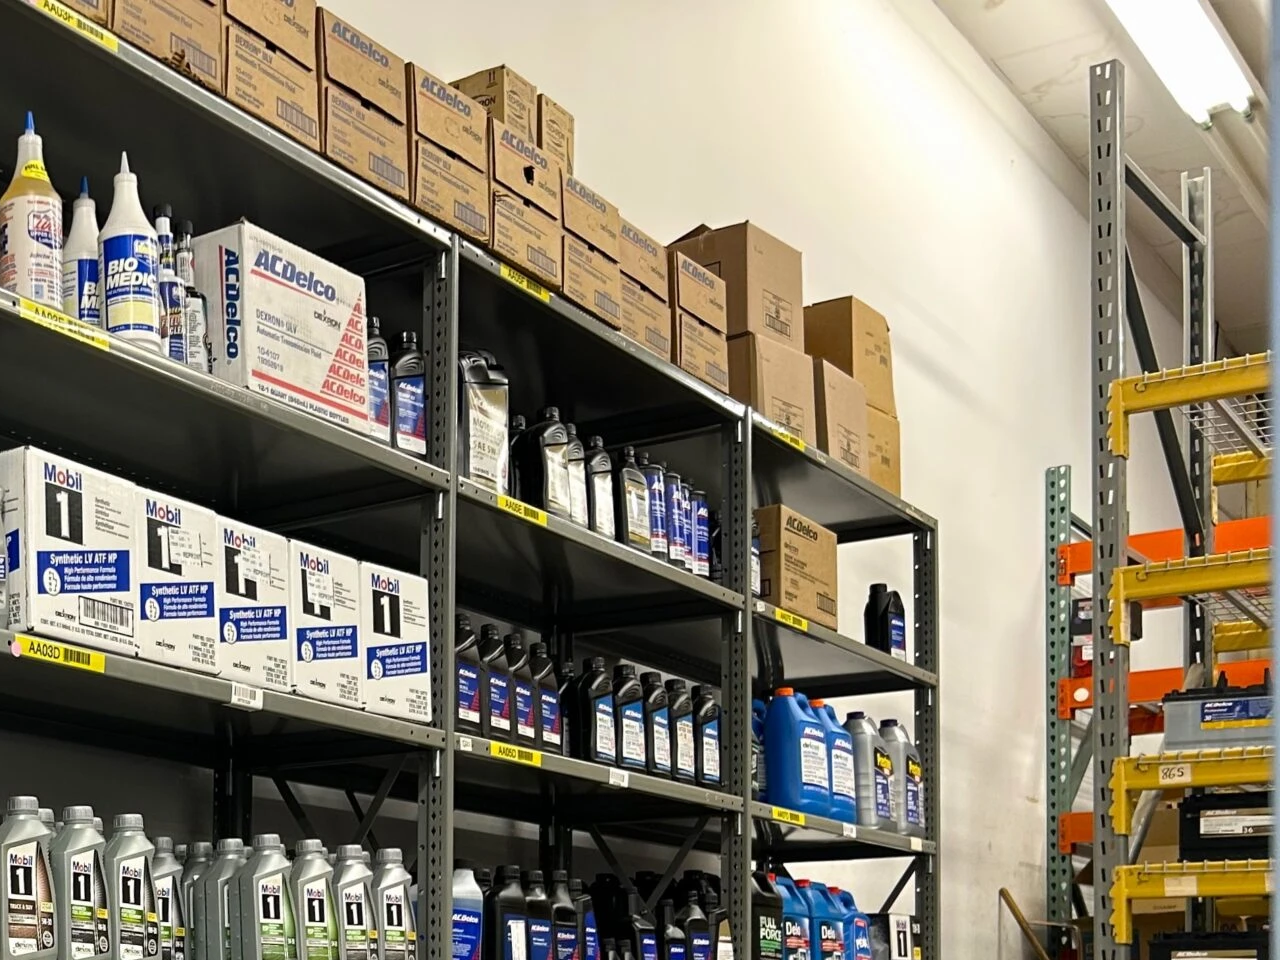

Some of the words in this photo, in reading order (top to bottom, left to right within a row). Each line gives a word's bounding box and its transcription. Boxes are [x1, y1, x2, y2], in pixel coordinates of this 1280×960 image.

[332, 20, 390, 69] ACDelco
[421, 75, 472, 118] ACDelco
[500, 129, 548, 169] ACDelco
[565, 177, 607, 213] ACDelco
[107, 257, 138, 274] BIO
[254, 248, 336, 302] ACDelco
[106, 273, 157, 288] MEDIC
[224, 248, 242, 360] ACDelco
[322, 379, 365, 405] ACDelco
[44, 462, 83, 491] Mobil
[56, 491, 70, 538] 1
[786, 516, 818, 541] ACDelco
[50, 553, 83, 565] Synthetic
[84, 553, 93, 564] LV
[94, 553, 106, 564] ATF
[108, 553, 118, 564] HP
[371, 573, 400, 594] Mobil
[29, 641, 61, 659] AA03D
[498, 747, 517, 759] AA05D
[10, 853, 33, 866] Mobil
[760, 916, 776, 928] FULL
[786, 922, 801, 935] Delo
[822, 926, 835, 939] Delo
[760, 927, 782, 941] FORCE
